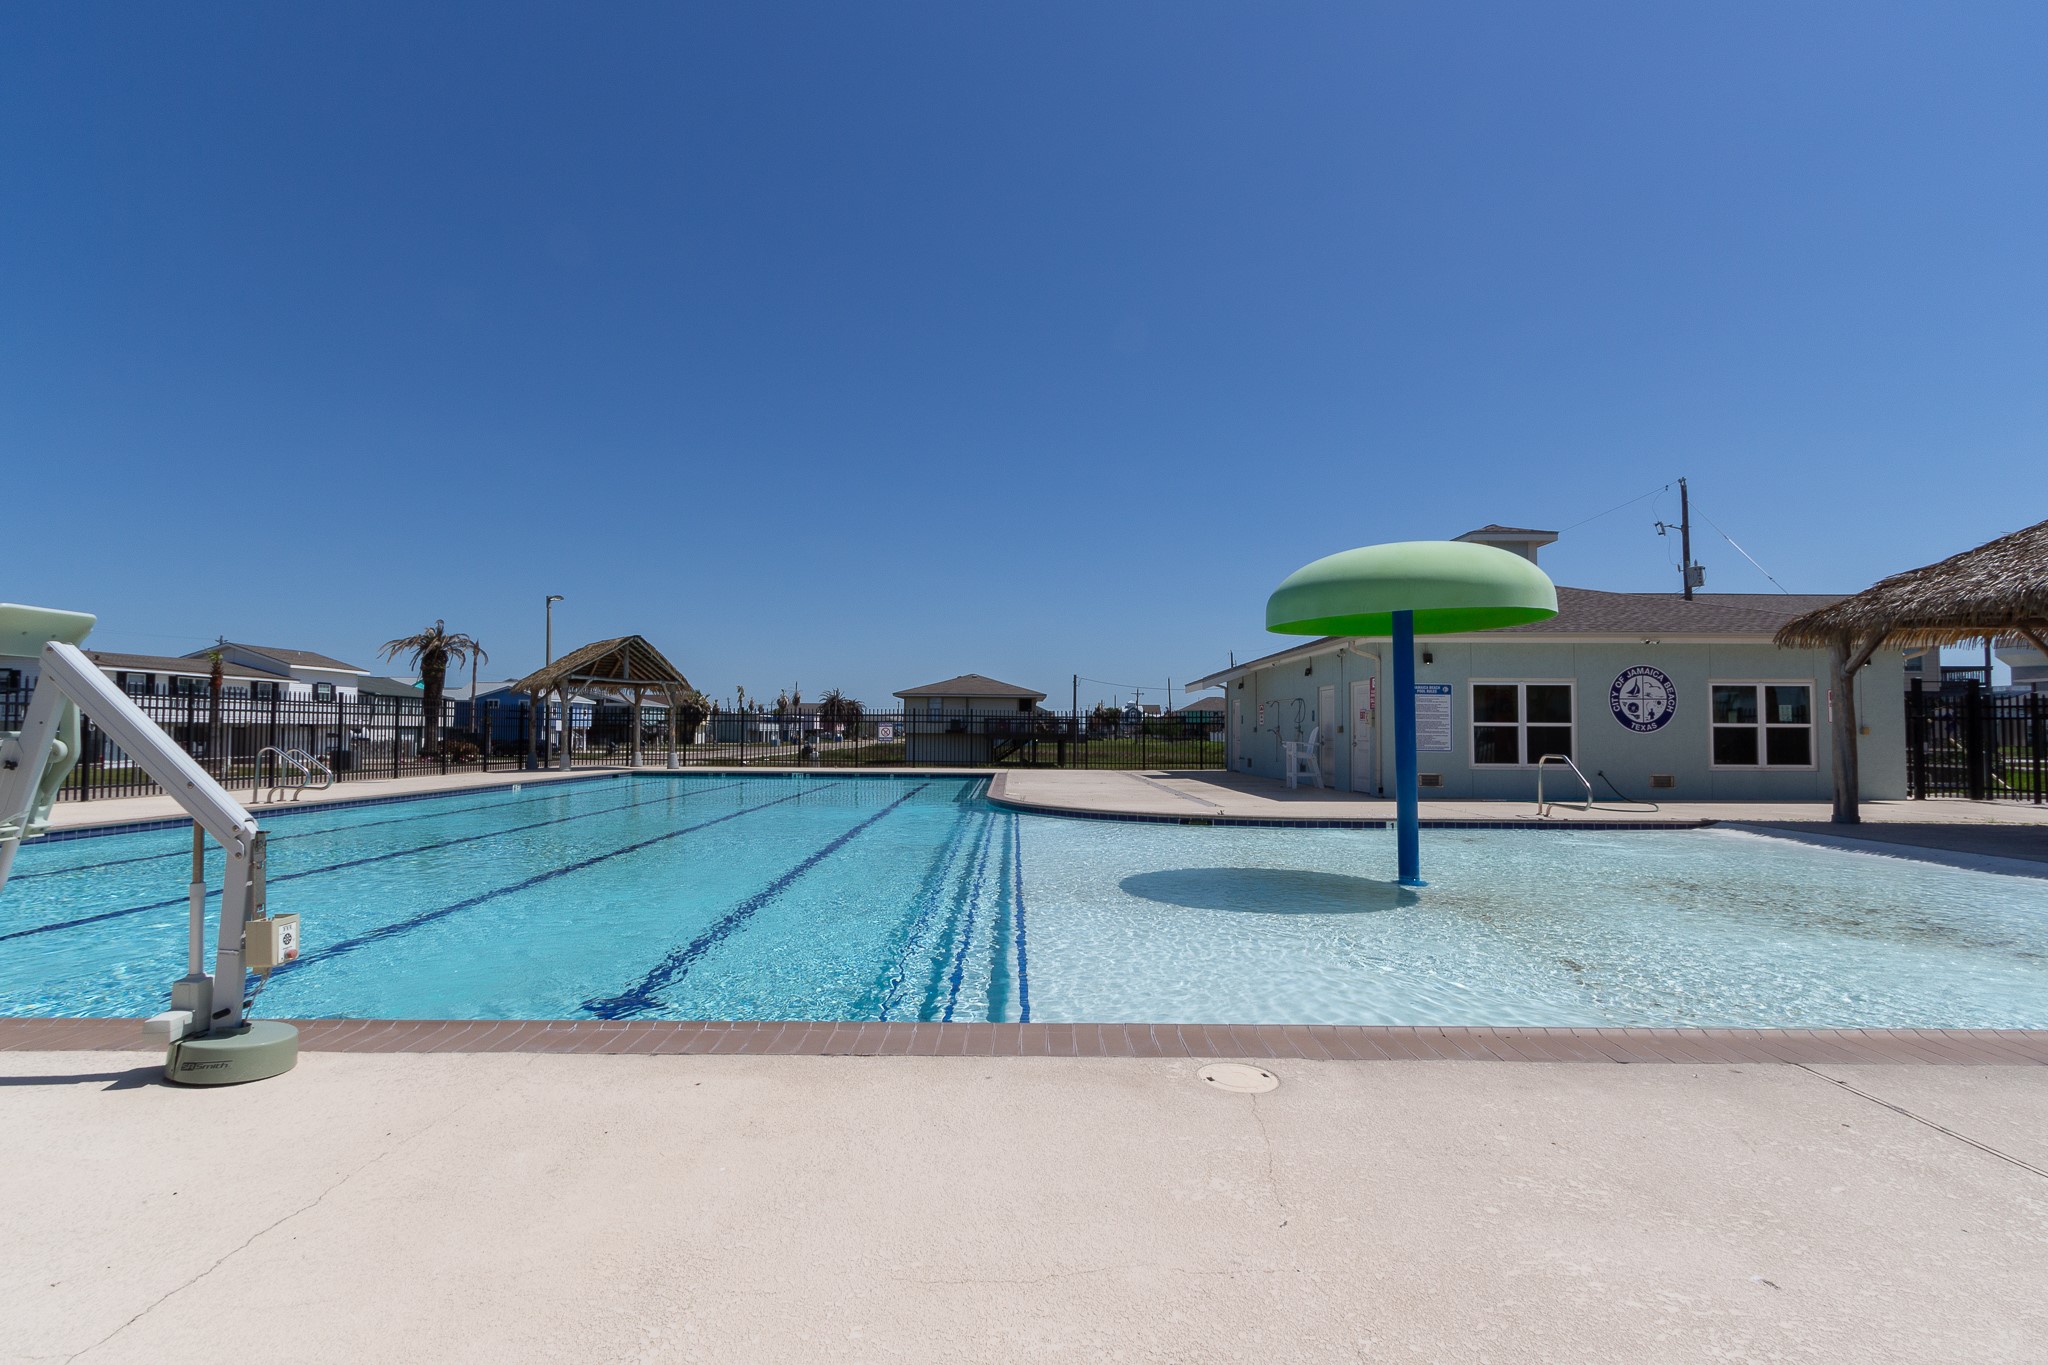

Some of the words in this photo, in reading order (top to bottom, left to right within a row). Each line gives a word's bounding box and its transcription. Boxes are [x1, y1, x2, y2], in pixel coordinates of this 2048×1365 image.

[1615, 676, 1625, 688] OF
[1626, 667, 1664, 682] JAMAICA
[1611, 691, 1620, 712] CITY
[1663, 681, 1675, 713] BEACH
[1630, 722, 1658, 731] TEXAS
